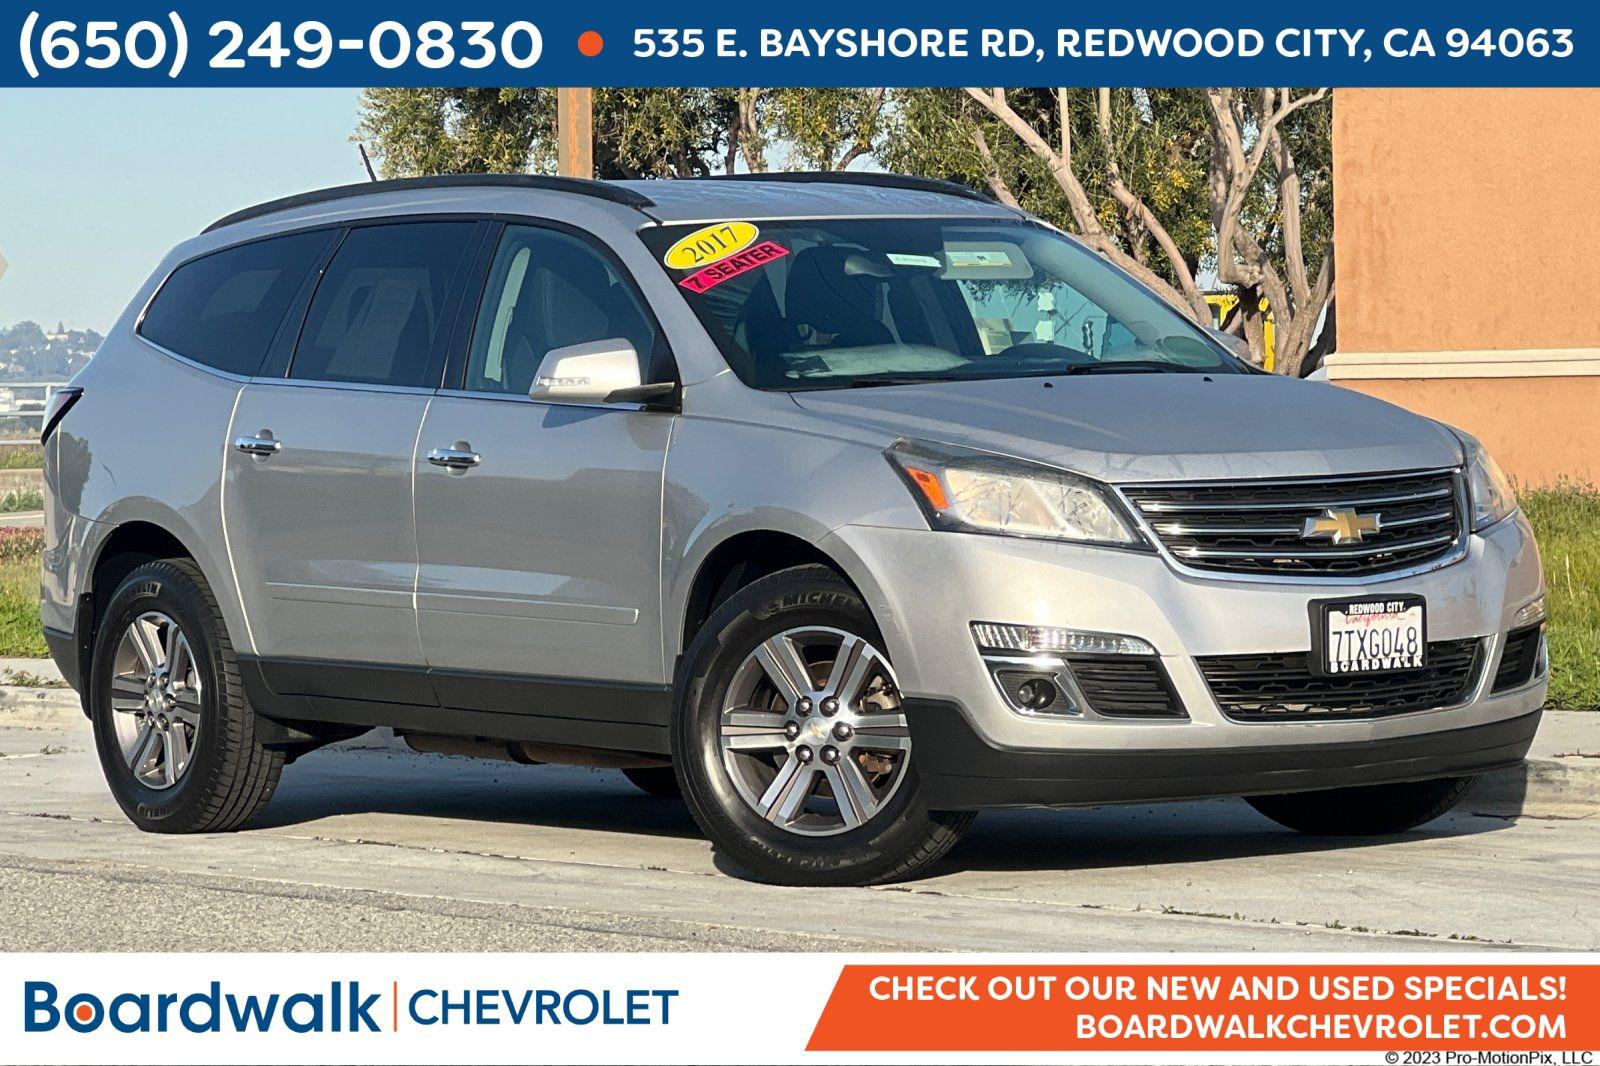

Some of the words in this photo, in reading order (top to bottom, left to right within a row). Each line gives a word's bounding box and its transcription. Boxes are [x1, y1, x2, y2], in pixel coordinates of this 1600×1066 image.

[682, 226, 738, 263] 2017
[686, 277, 703, 289] 7
[704, 245, 779, 280] SEATER
[1349, 603, 1385, 615] REDWOOD
[1332, 627, 1418, 661] 7TXG048
[1330, 655, 1422, 673] BOARDWALK
